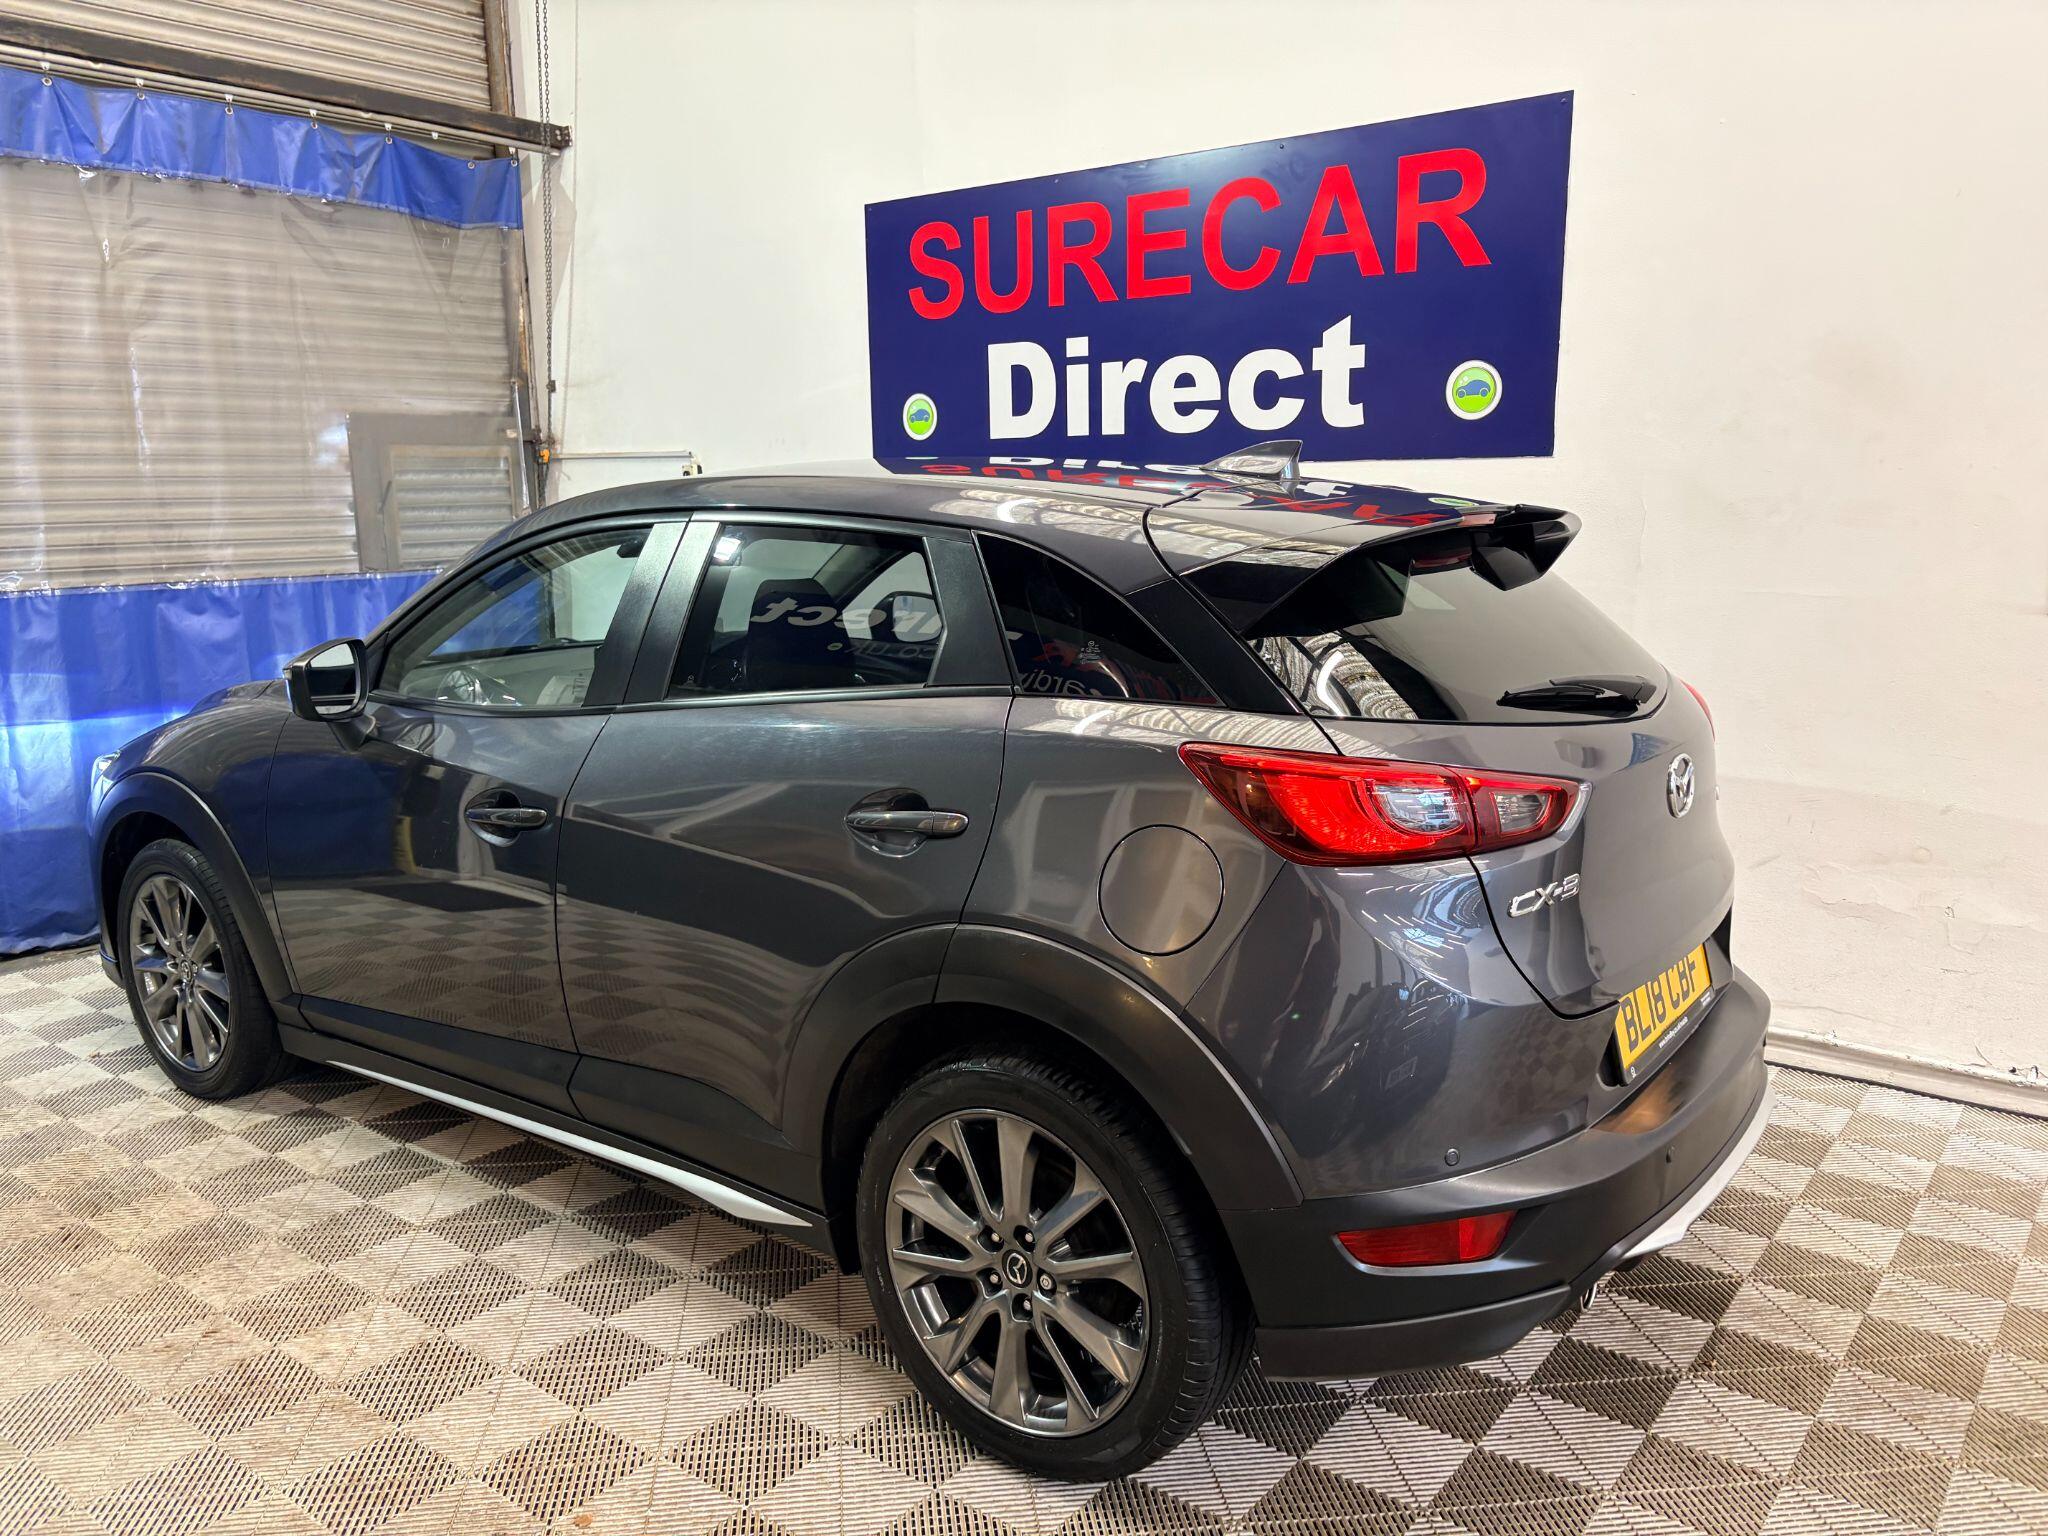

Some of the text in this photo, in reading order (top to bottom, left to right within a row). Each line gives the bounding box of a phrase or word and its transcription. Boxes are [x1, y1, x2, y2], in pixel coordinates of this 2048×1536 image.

[908, 147, 1492, 320] SURECAR
[987, 315, 1366, 440] Direct
[1507, 873, 1581, 918] CX-3
[1620, 978, 1667, 1053] BL18
[1666, 955, 1697, 1010] CBF
